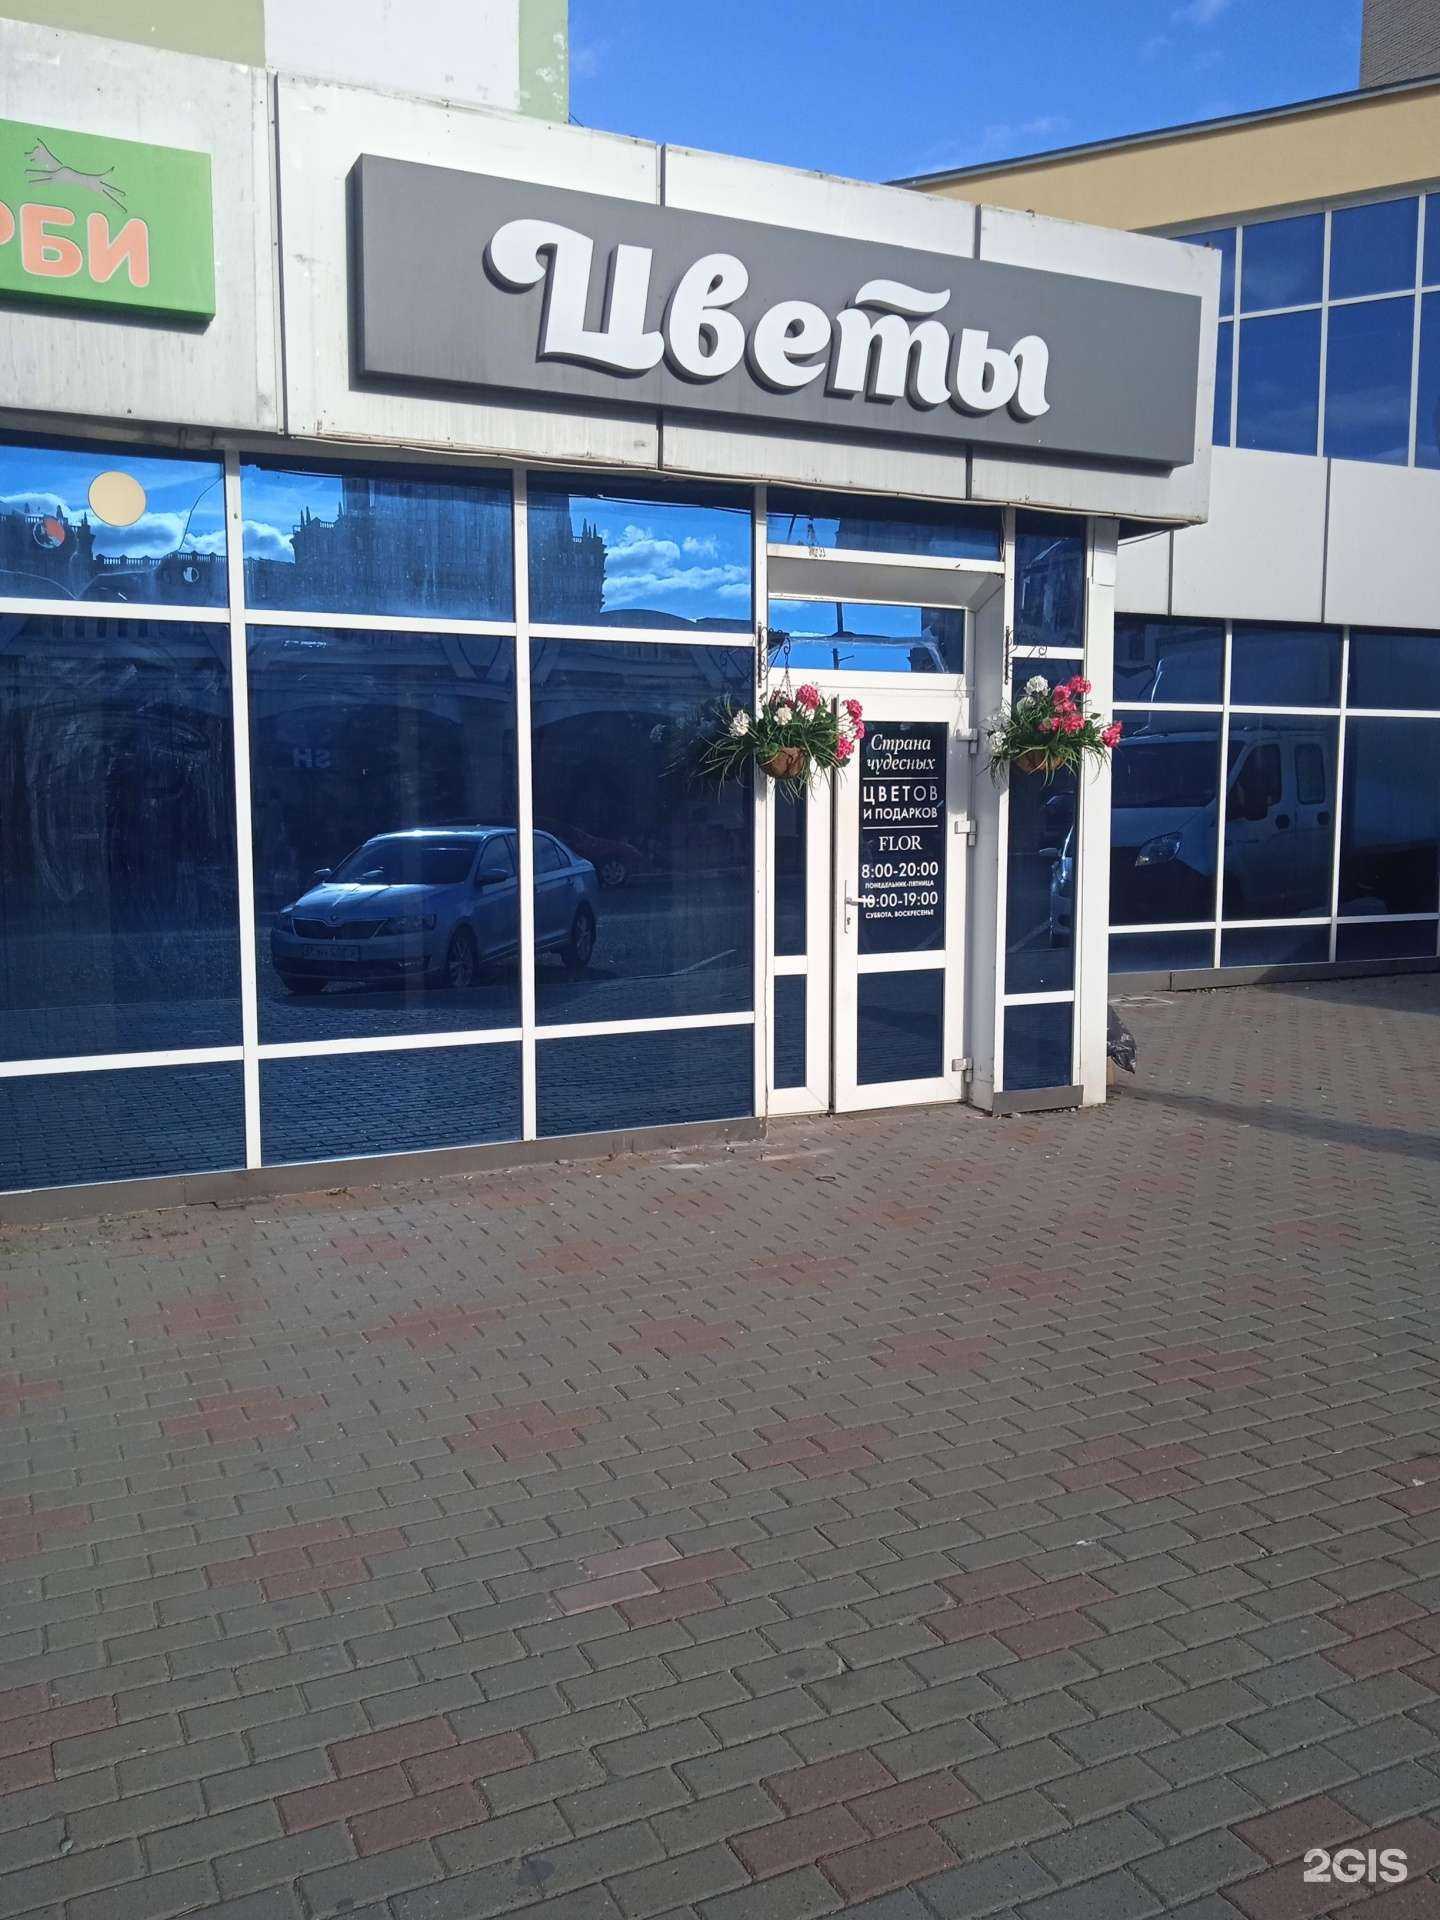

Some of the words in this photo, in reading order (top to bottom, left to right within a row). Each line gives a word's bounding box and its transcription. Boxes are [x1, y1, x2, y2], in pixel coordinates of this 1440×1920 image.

[488, 218, 1050, 417] Цветы
[871, 733, 931, 755] Страна
[866, 752, 936, 776] чудесных
[863, 785, 938, 806] ЦВЕТОВ
[863, 808, 872, 820] И
[875, 807, 938, 821] ПОДАРКОВ
[878, 835, 923, 851] FLOR
[861, 861, 939, 878] 8:00-20:00
